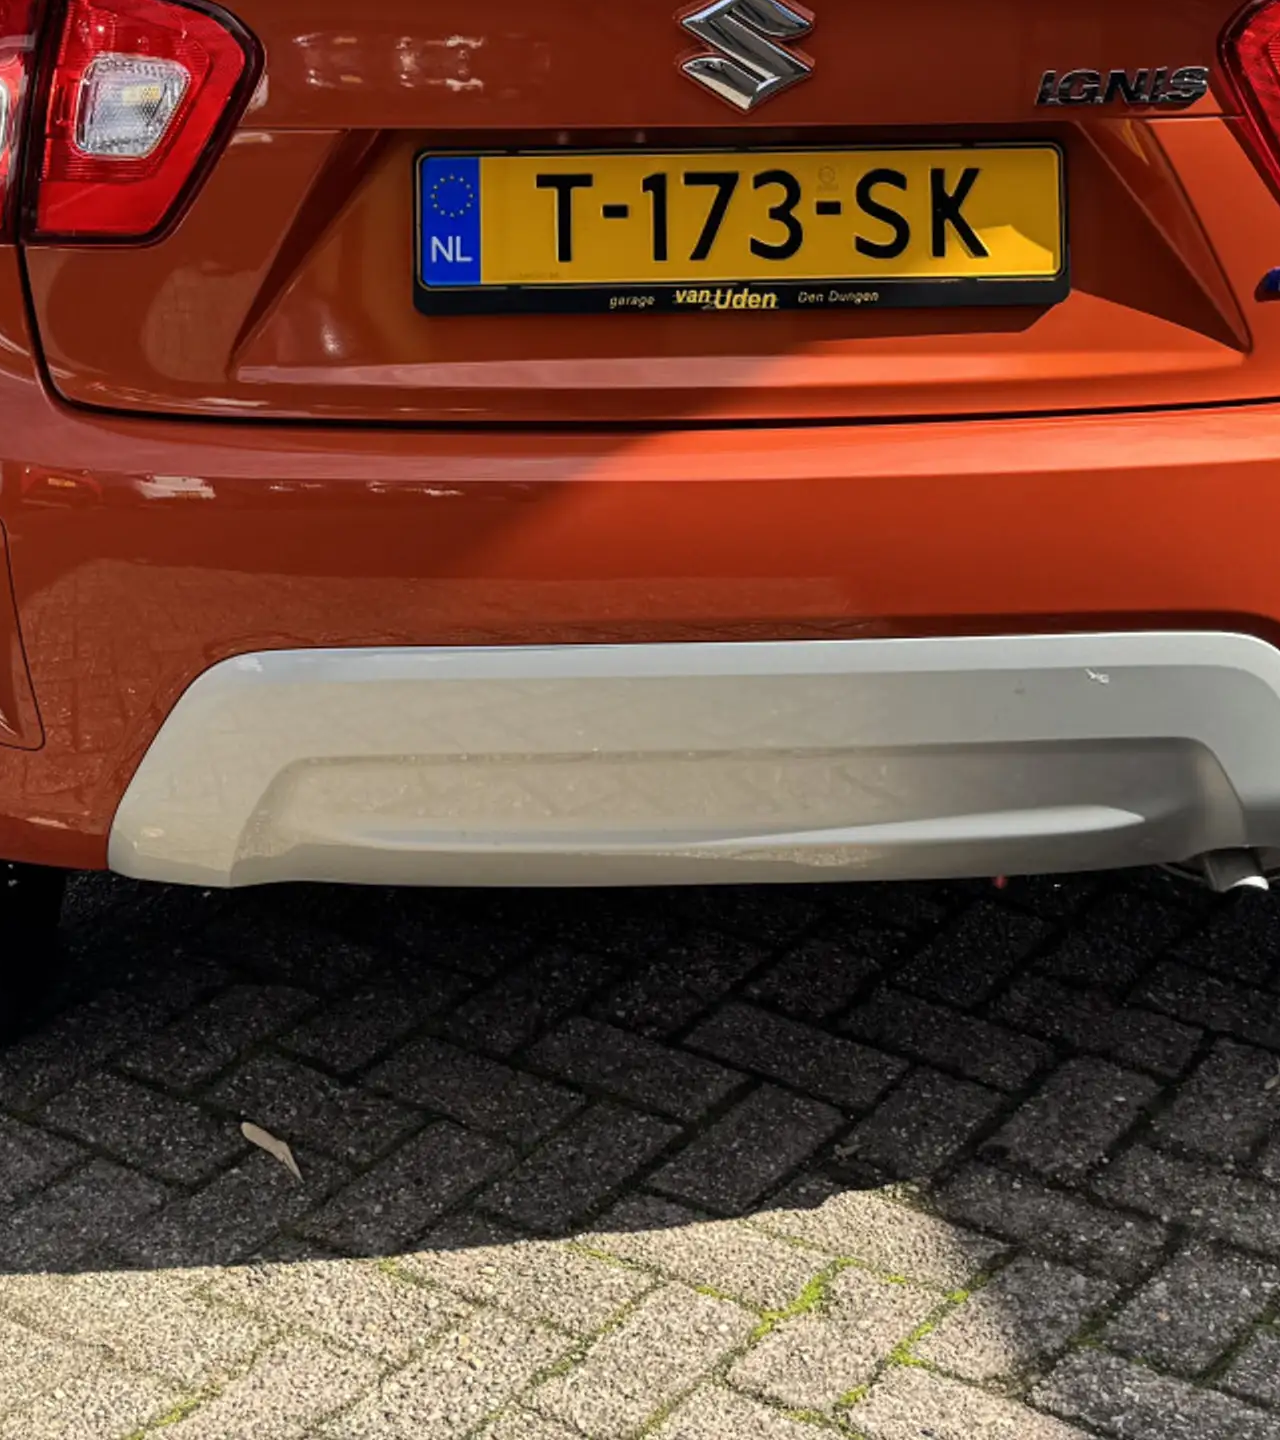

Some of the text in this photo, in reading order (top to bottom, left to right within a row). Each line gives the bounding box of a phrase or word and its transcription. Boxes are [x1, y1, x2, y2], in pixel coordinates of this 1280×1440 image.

[1035, 65, 1209, 106] IGNIS
[536, 168, 989, 262] T-173-SK
[430, 235, 473, 263] NL
[609, 295, 656, 309] garage
[675, 289, 711, 304] van
[714, 288, 778, 310] Uden
[798, 291, 824, 303] Den
